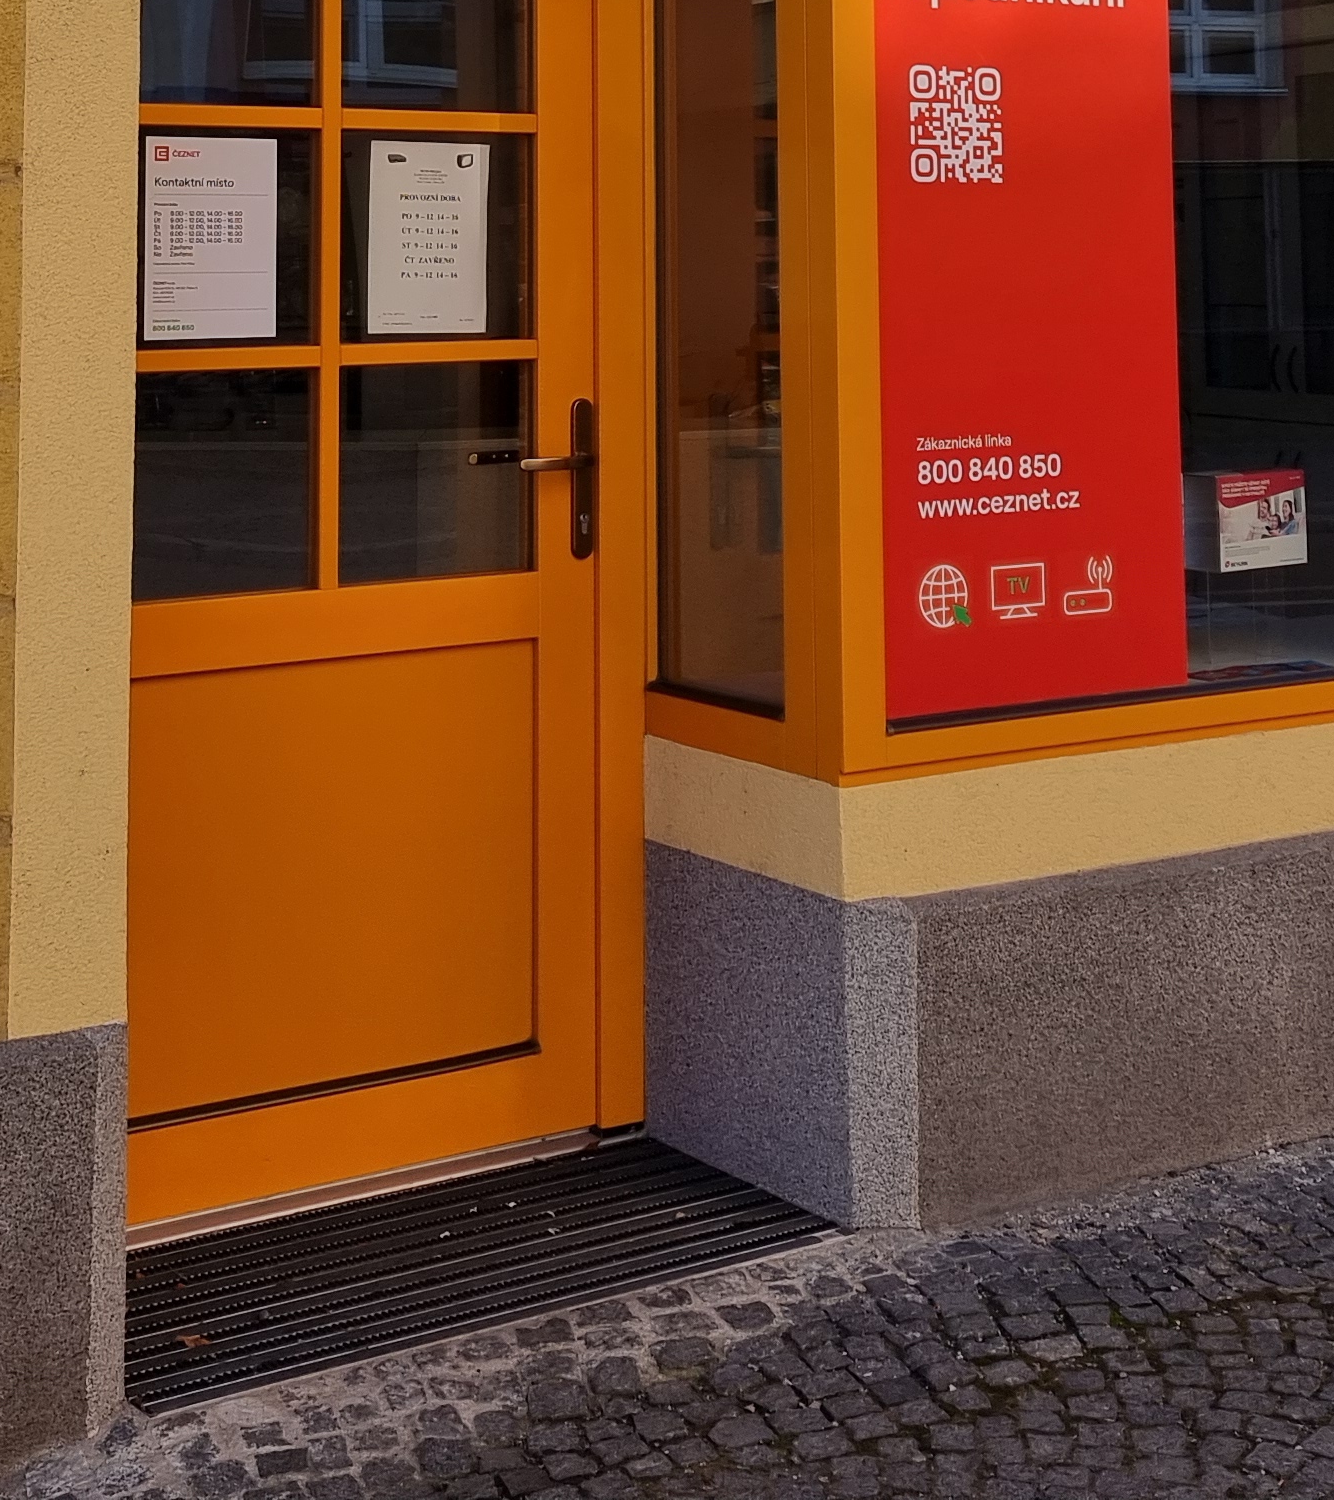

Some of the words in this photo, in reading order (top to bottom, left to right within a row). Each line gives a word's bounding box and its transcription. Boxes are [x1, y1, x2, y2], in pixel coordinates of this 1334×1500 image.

[154, 176, 205, 188] Kontaktní
[206, 177, 235, 188] místo
[400, 194, 439, 202] PROVOZNÍ
[418, 256, 455, 264] ZAVŘENO
[916, 434, 983, 452] Zákaznická
[985, 433, 1012, 448] linka
[917, 459, 963, 485] 800
[968, 456, 1013, 482] 840
[1018, 453, 1062, 479] 850
[917, 488, 1081, 519] www.ceznet.cz
[1006, 576, 1030, 595] TV
